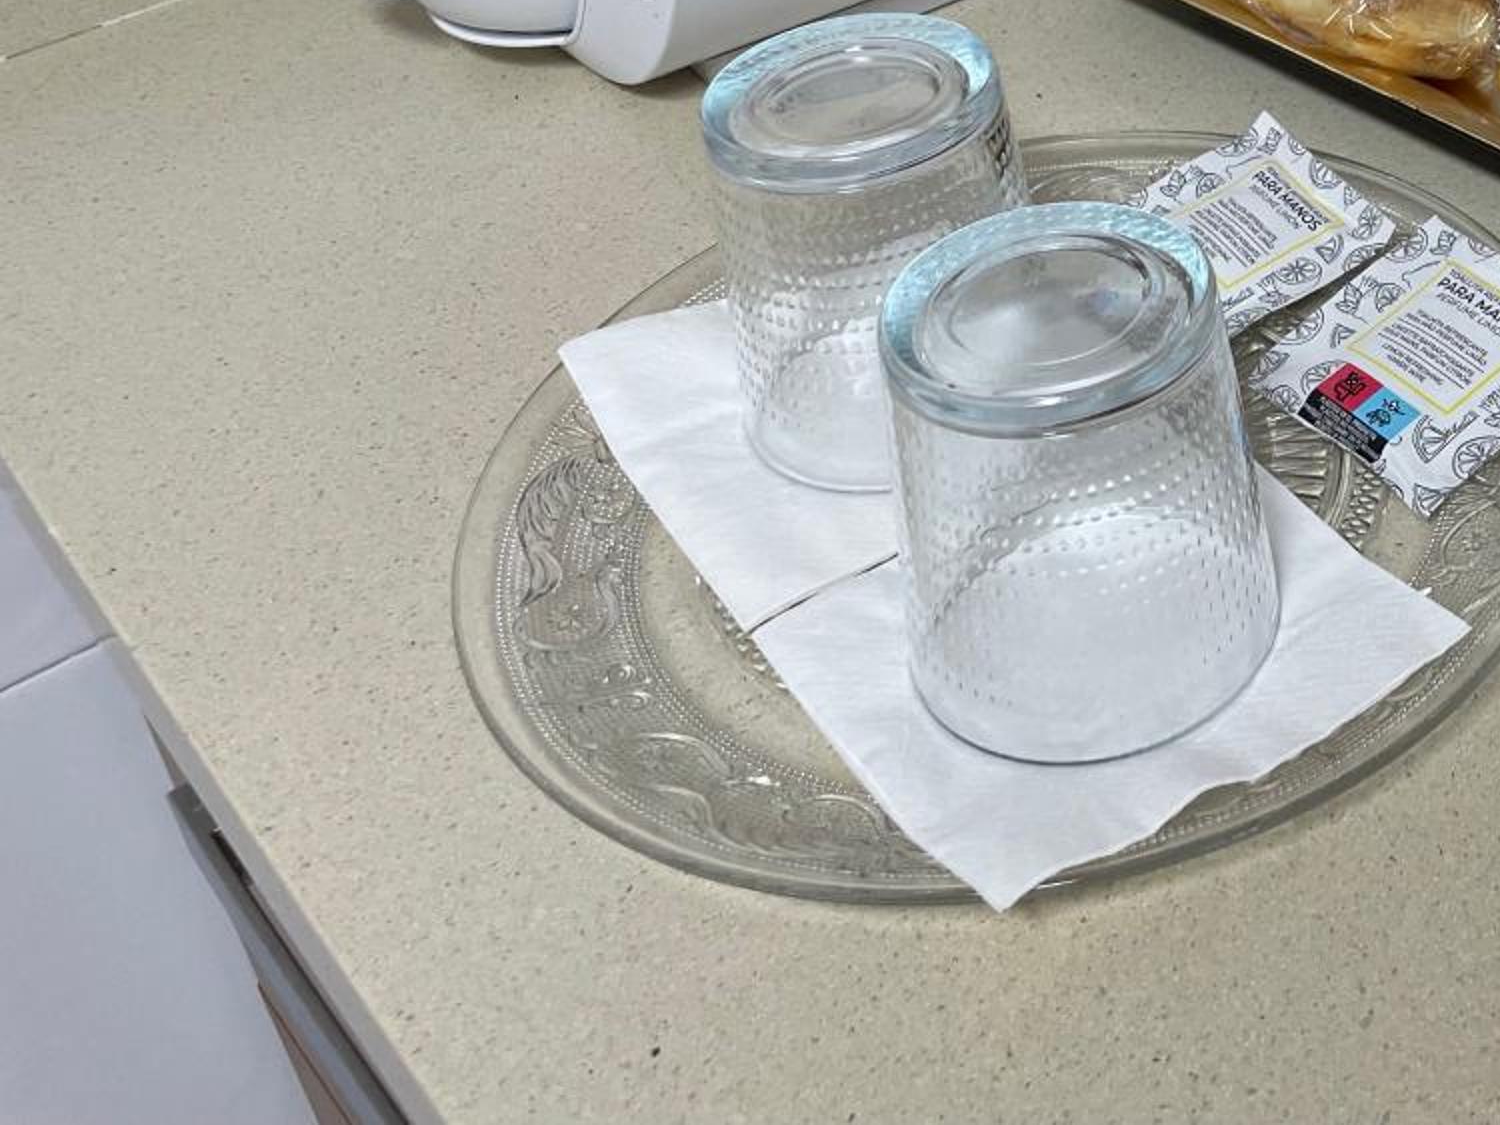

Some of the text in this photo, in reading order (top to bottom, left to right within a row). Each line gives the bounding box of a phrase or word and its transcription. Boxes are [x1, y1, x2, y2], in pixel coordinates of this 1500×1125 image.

[1252, 171, 1282, 199] PARA
[1281, 193, 1322, 231] MANOS
[1438, 276, 1477, 304] PARA
